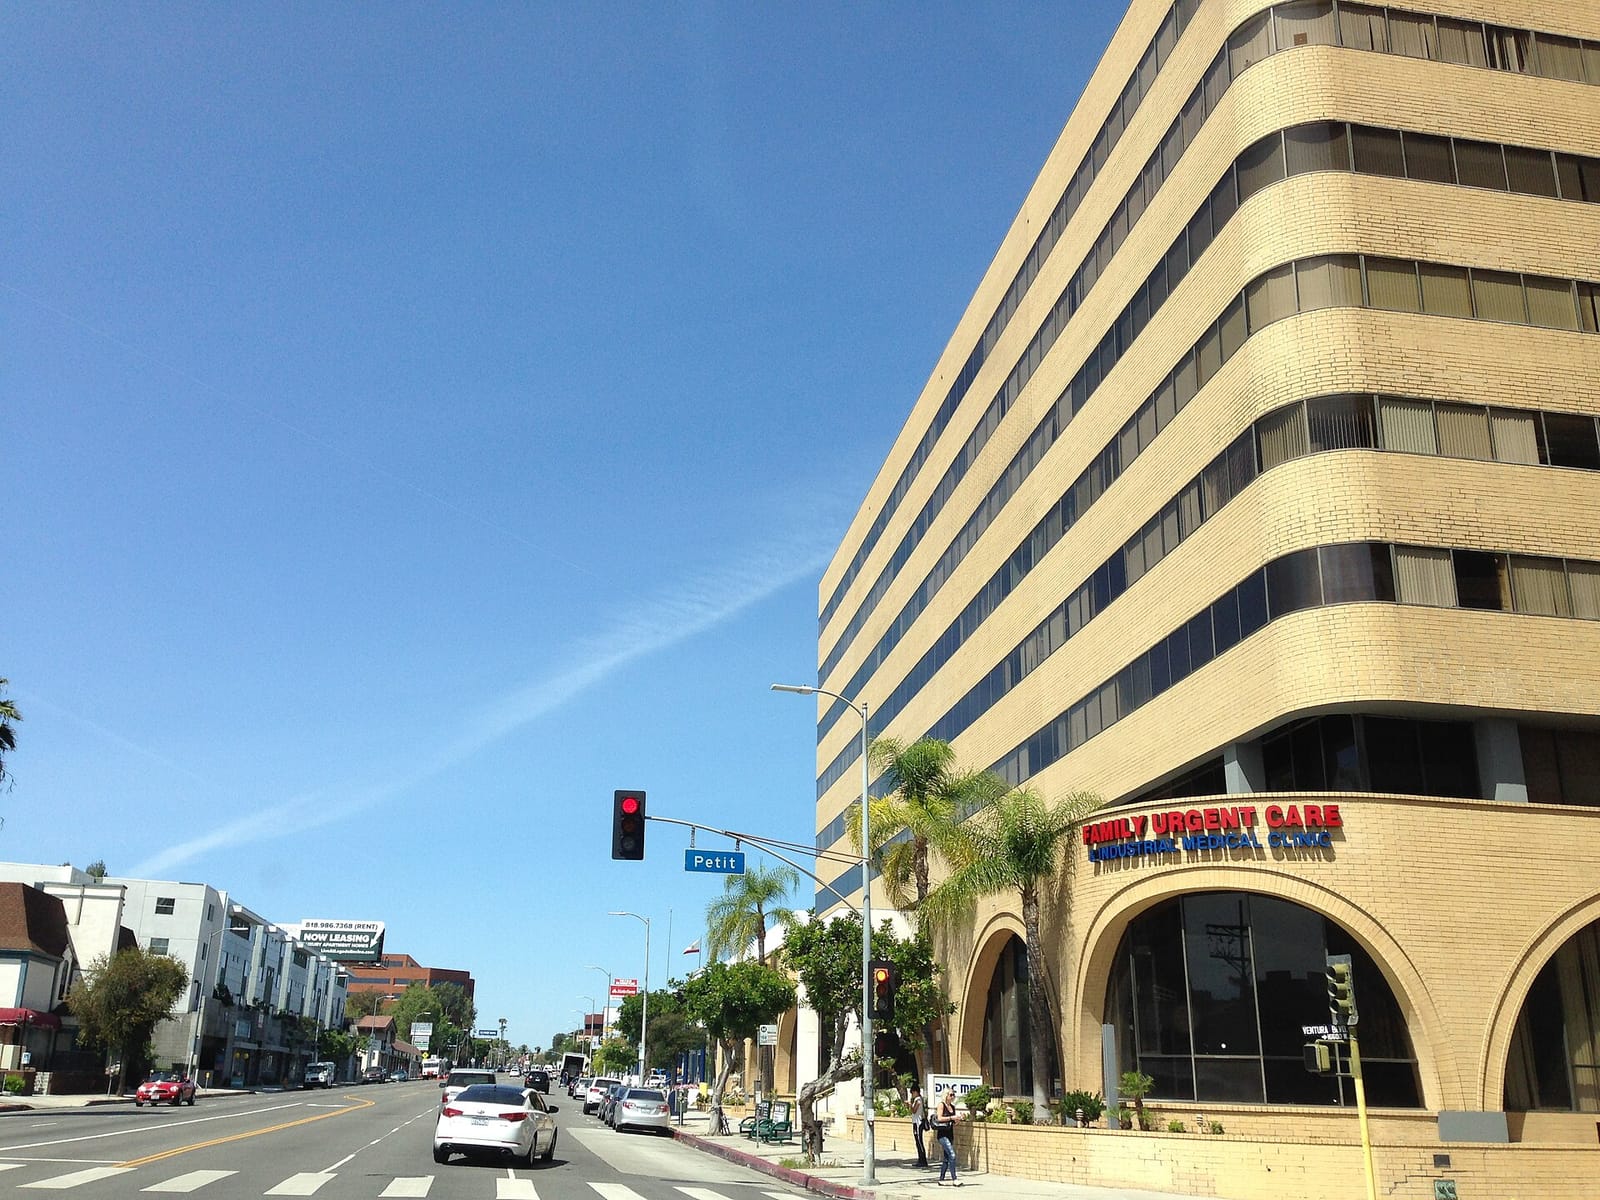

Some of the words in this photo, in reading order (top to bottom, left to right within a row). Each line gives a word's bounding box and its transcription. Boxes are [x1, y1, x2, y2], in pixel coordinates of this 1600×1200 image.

[1082, 815, 1147, 845] FAMILY
[1151, 806, 1257, 834] URGENT
[1265, 804, 1343, 828] CARE
[1099, 838, 1177, 861] INDUSTRIAL
[1182, 832, 1263, 851] MEDICAL
[1267, 831, 1332, 848] CLINIC
[694, 855, 736, 869] Petit
[303, 933, 328, 941] NOW
[329, 934, 369, 943] LEASING
[1302, 1025, 1329, 1035] VENTURA
